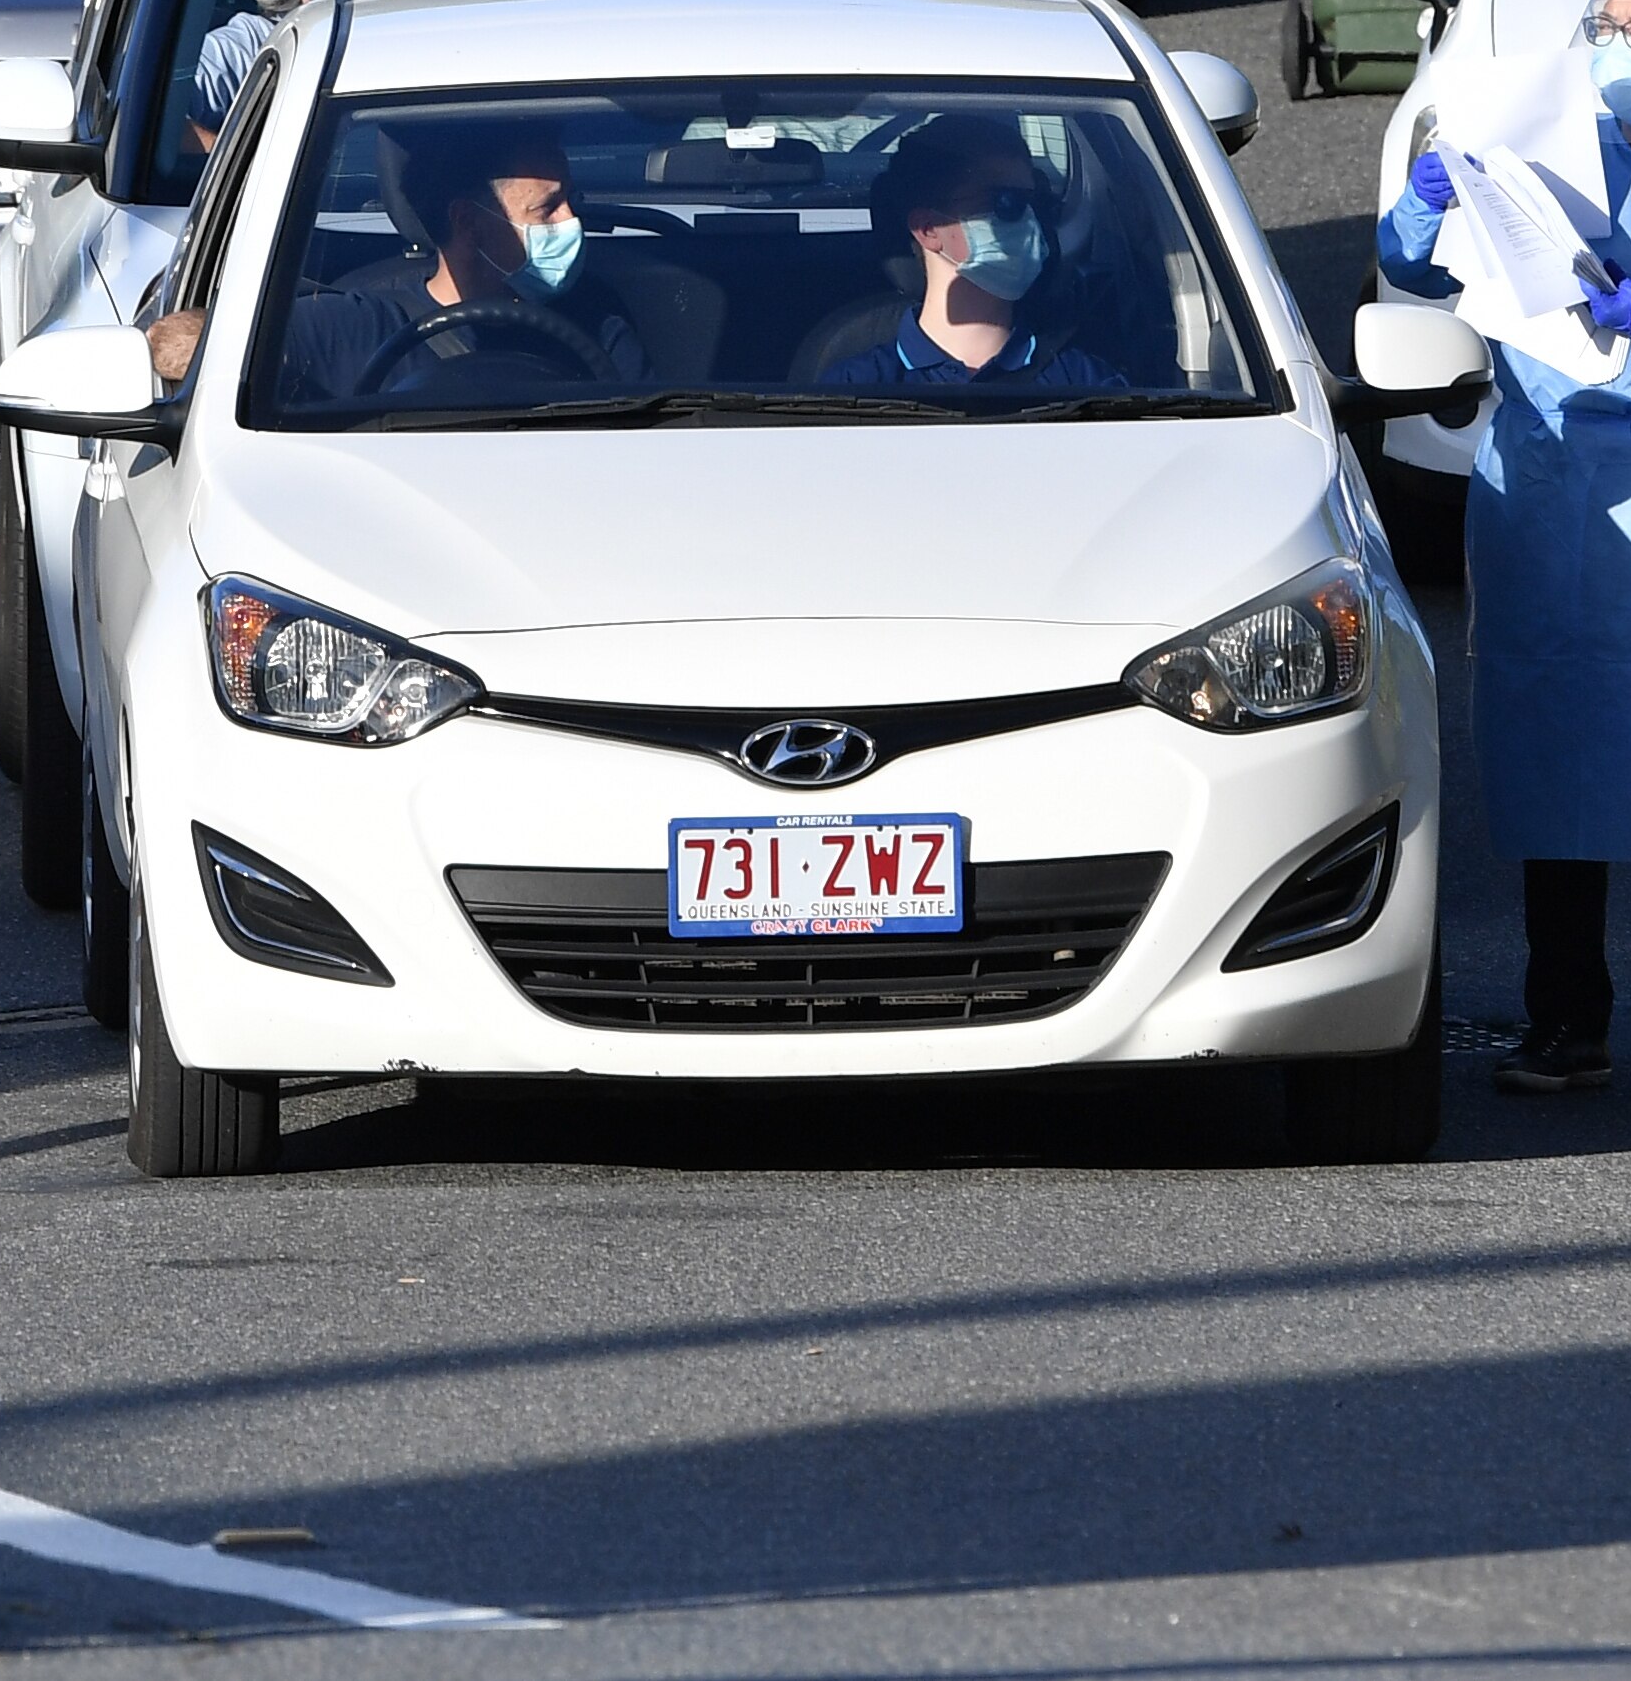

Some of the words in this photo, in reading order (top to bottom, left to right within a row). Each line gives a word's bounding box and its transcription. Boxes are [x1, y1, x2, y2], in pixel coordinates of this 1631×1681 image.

[776, 816, 800, 827] CAR
[802, 815, 853, 826] RENTALS
[688, 903, 792, 919] QUEENSLAND
[811, 901, 889, 917] SUNSHINE
[899, 900, 945, 915] STATE
